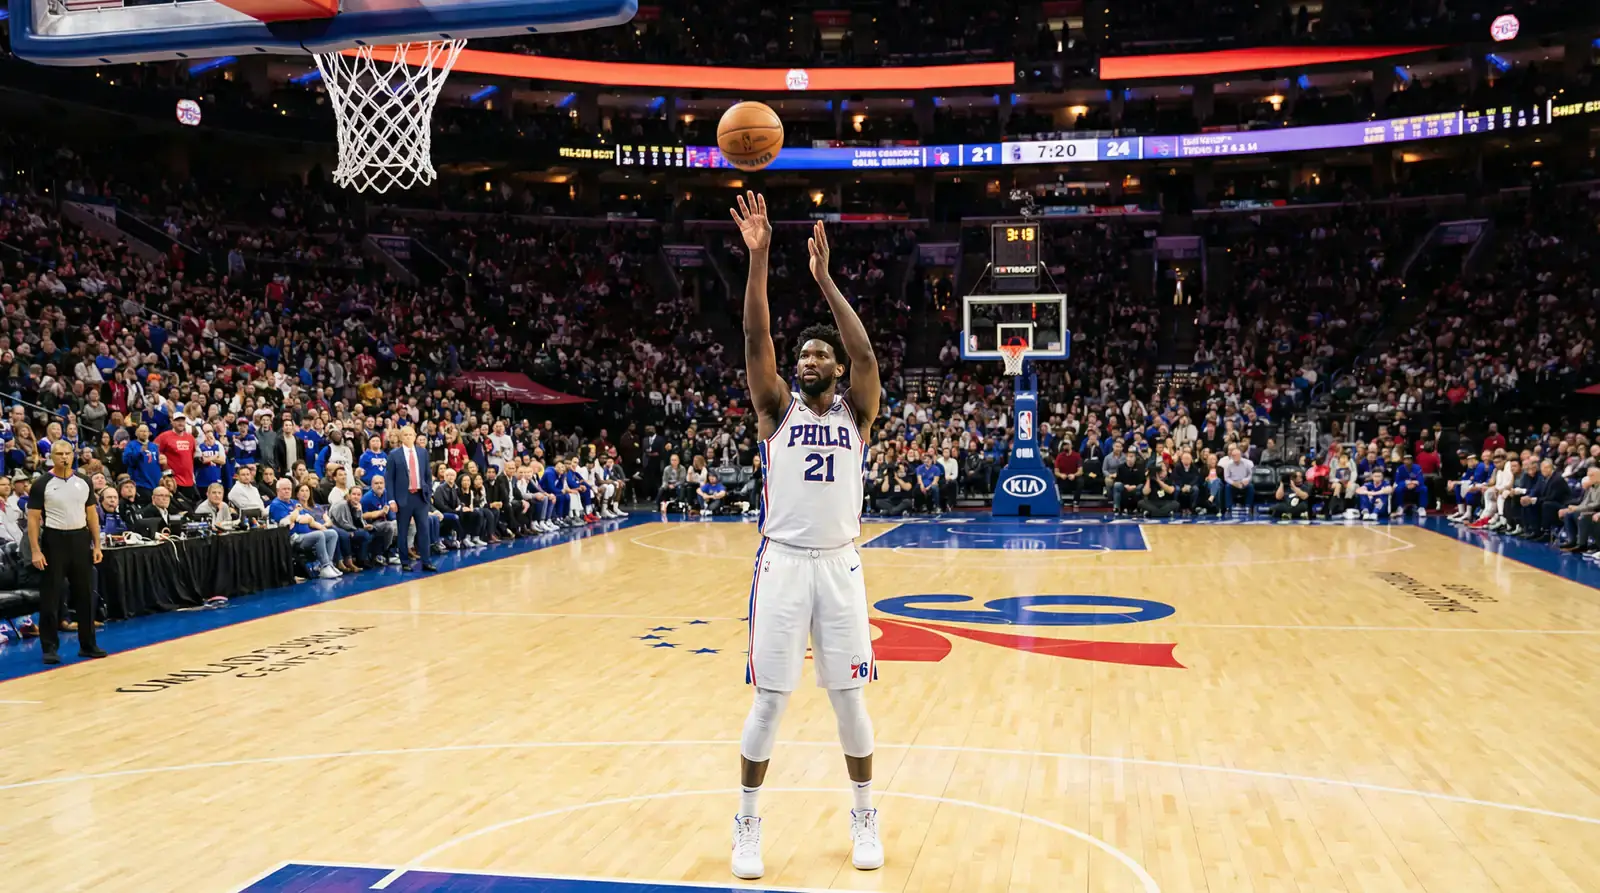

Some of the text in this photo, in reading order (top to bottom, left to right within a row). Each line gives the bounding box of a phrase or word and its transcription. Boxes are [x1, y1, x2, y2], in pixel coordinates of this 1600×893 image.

[971, 146, 993, 162] 21
[1038, 144, 1077, 158] 7:20
[1106, 141, 1130, 157] 24
[787, 424, 852, 451] PHILA
[804, 452, 836, 483] 21
[1010, 479, 1040, 493] KIA
[850, 661, 869, 680] 76
